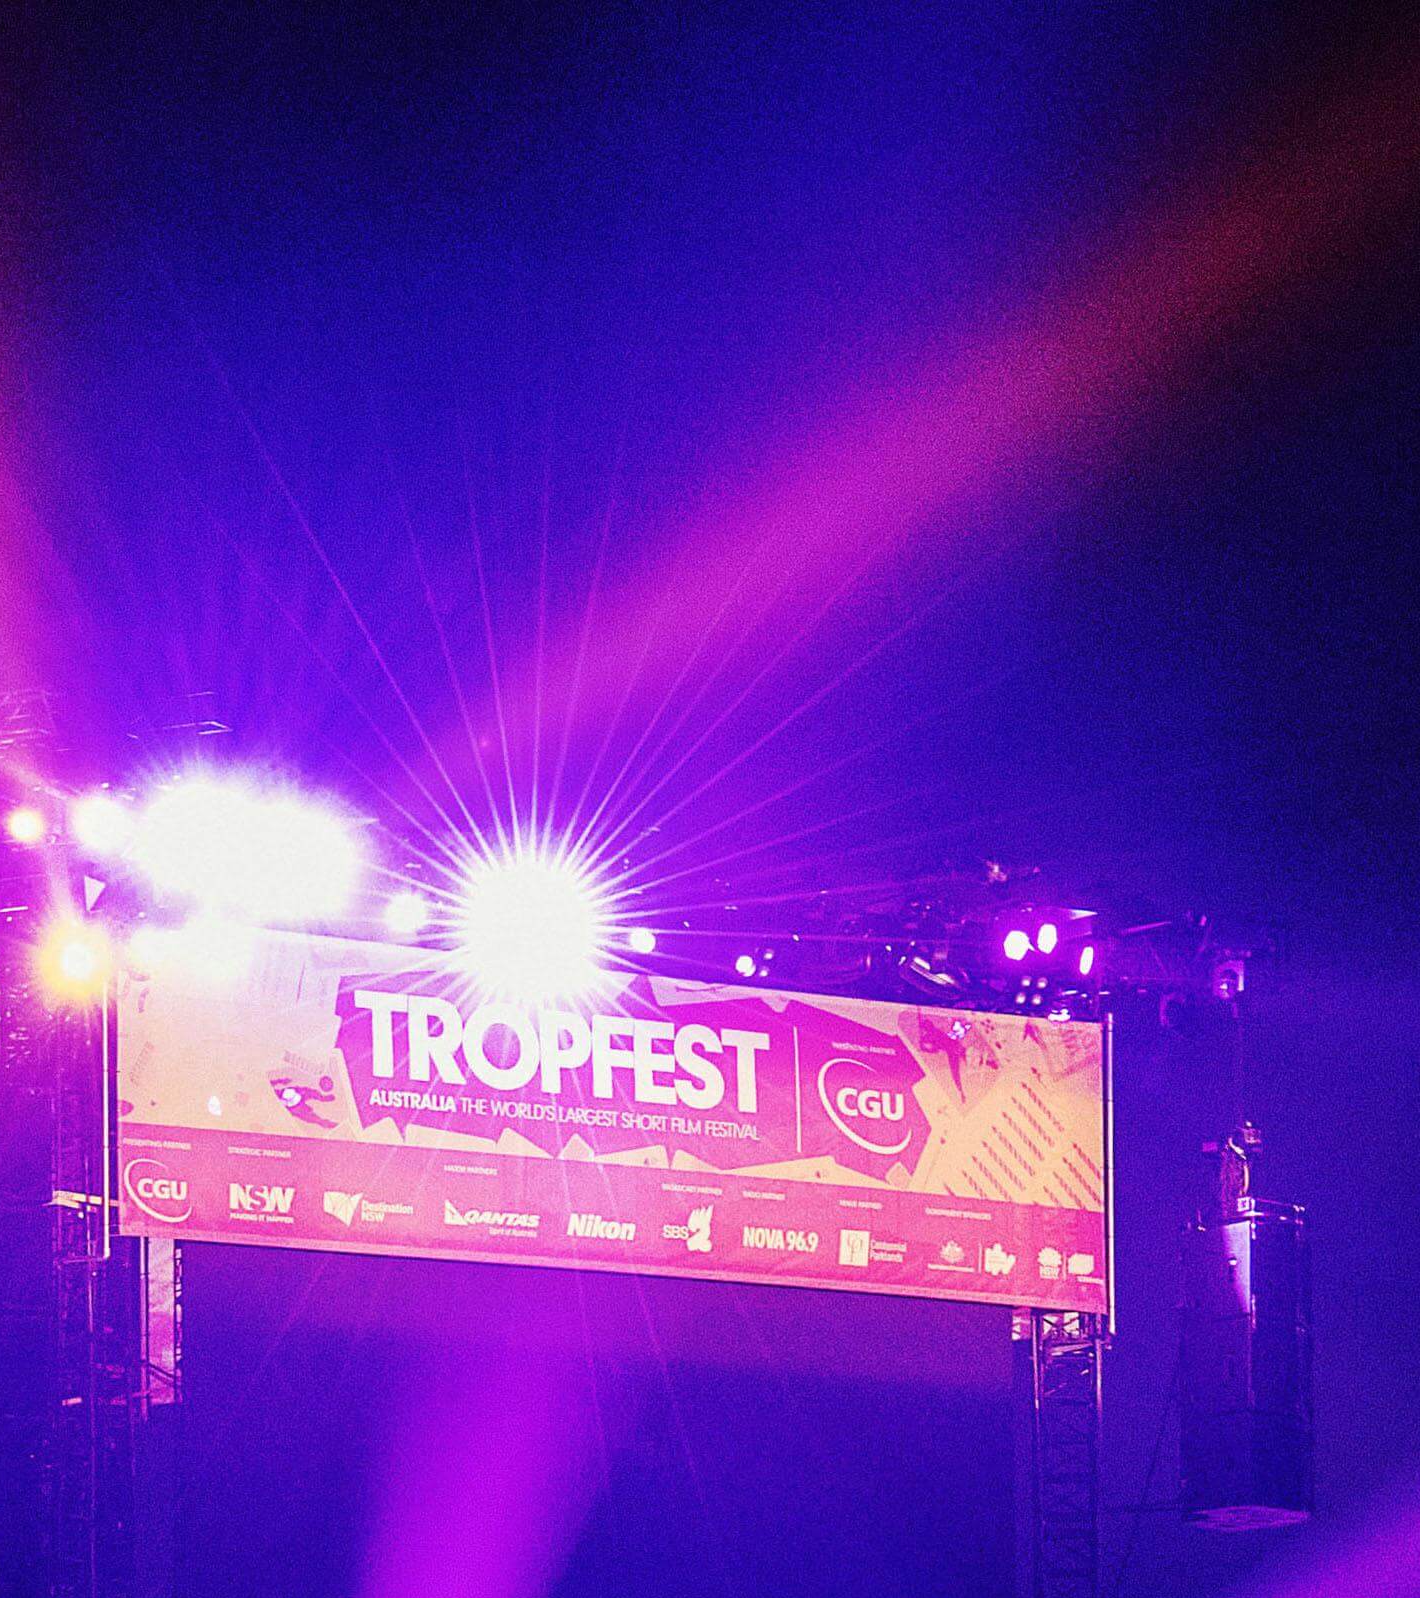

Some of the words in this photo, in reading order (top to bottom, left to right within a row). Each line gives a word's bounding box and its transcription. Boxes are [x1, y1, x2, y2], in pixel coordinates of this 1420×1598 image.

[354, 989, 770, 1114] TROPFEST
[369, 1089, 457, 1113] AUSTRALIA
[459, 1097, 487, 1116] THE
[558, 1105, 618, 1127] LARGEST
[621, 1112, 668, 1132] SHORT
[671, 1117, 702, 1136] FILM
[704, 1119, 760, 1141] FESTIVAL
[835, 1087, 905, 1121] CGU
[136, 1177, 188, 1201] CGU
[229, 1182, 296, 1214] NSW
[361, 1199, 414, 1214] Destination
[463, 1208, 541, 1228] QANTAS
[566, 1213, 636, 1241] Nikon
[662, 1224, 689, 1240] SBS
[742, 1226, 784, 1249] NOVA
[786, 1230, 819, 1252] 96.9
